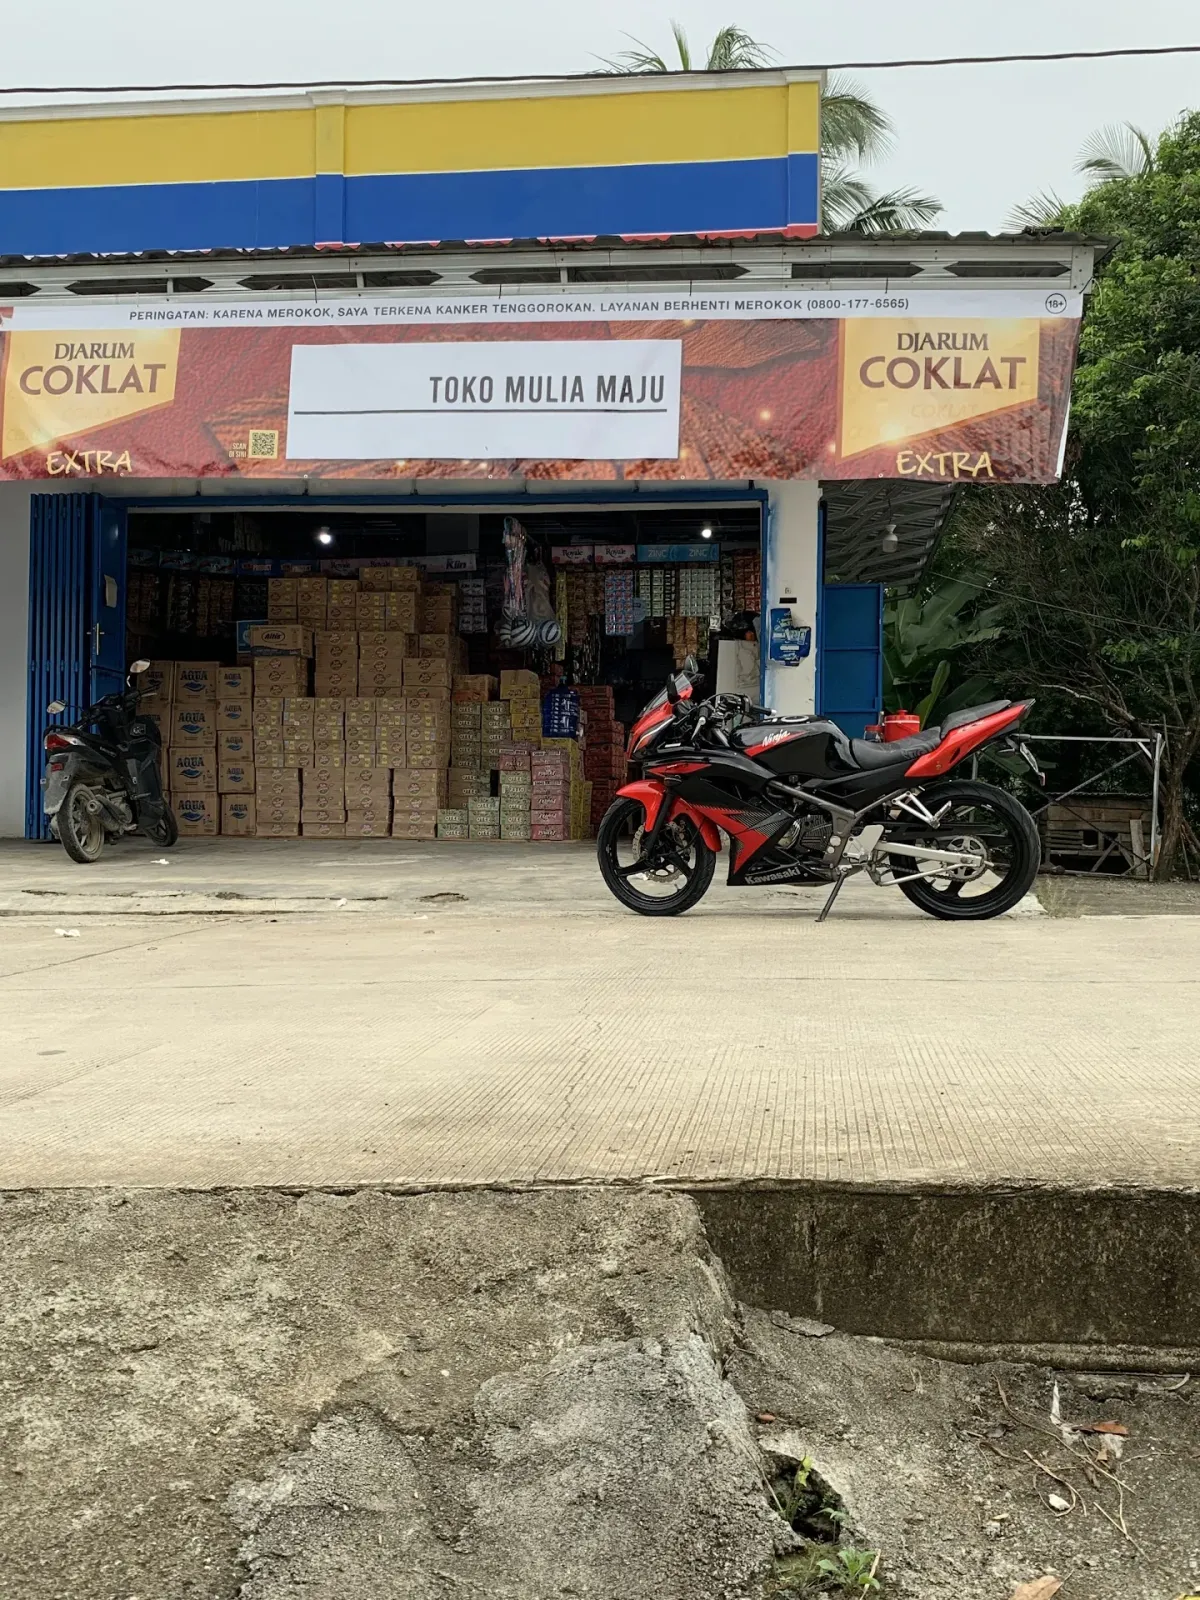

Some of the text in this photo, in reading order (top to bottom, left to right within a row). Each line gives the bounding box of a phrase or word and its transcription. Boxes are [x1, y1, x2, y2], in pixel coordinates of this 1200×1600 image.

[129, 298, 909, 321] PERINGATAN: KARENA MEROKOK, SAYA TERKENA KANKER TENGGOROKAN. LAYANAN BERHENTI MEROKOK (0800-177-6565)
[1047, 300, 1064, 309] 18+
[897, 332, 989, 351] DJARUM
[54, 342, 135, 361] DJARUM
[19, 363, 166, 395] COKLAT
[859, 356, 1027, 390] COKLAT
[429, 375, 665, 404] TOKO MULIA MAJU
[232, 442, 247, 450] SCAN
[46, 450, 133, 475] EXTRA
[896, 450, 994, 478] EXTRA
[605, 547, 626, 558] Royale
[647, 549, 668, 558] ZINC
[688, 548, 708, 557] ZINC
[180, 670, 208, 681] AQUA
[178, 712, 206, 723] AQUA
[762, 729, 791, 747] Ninja
[176, 757, 205, 768] AQUA
[178, 800, 206, 811] AQUA
[744, 866, 801, 885] Kawasaki
